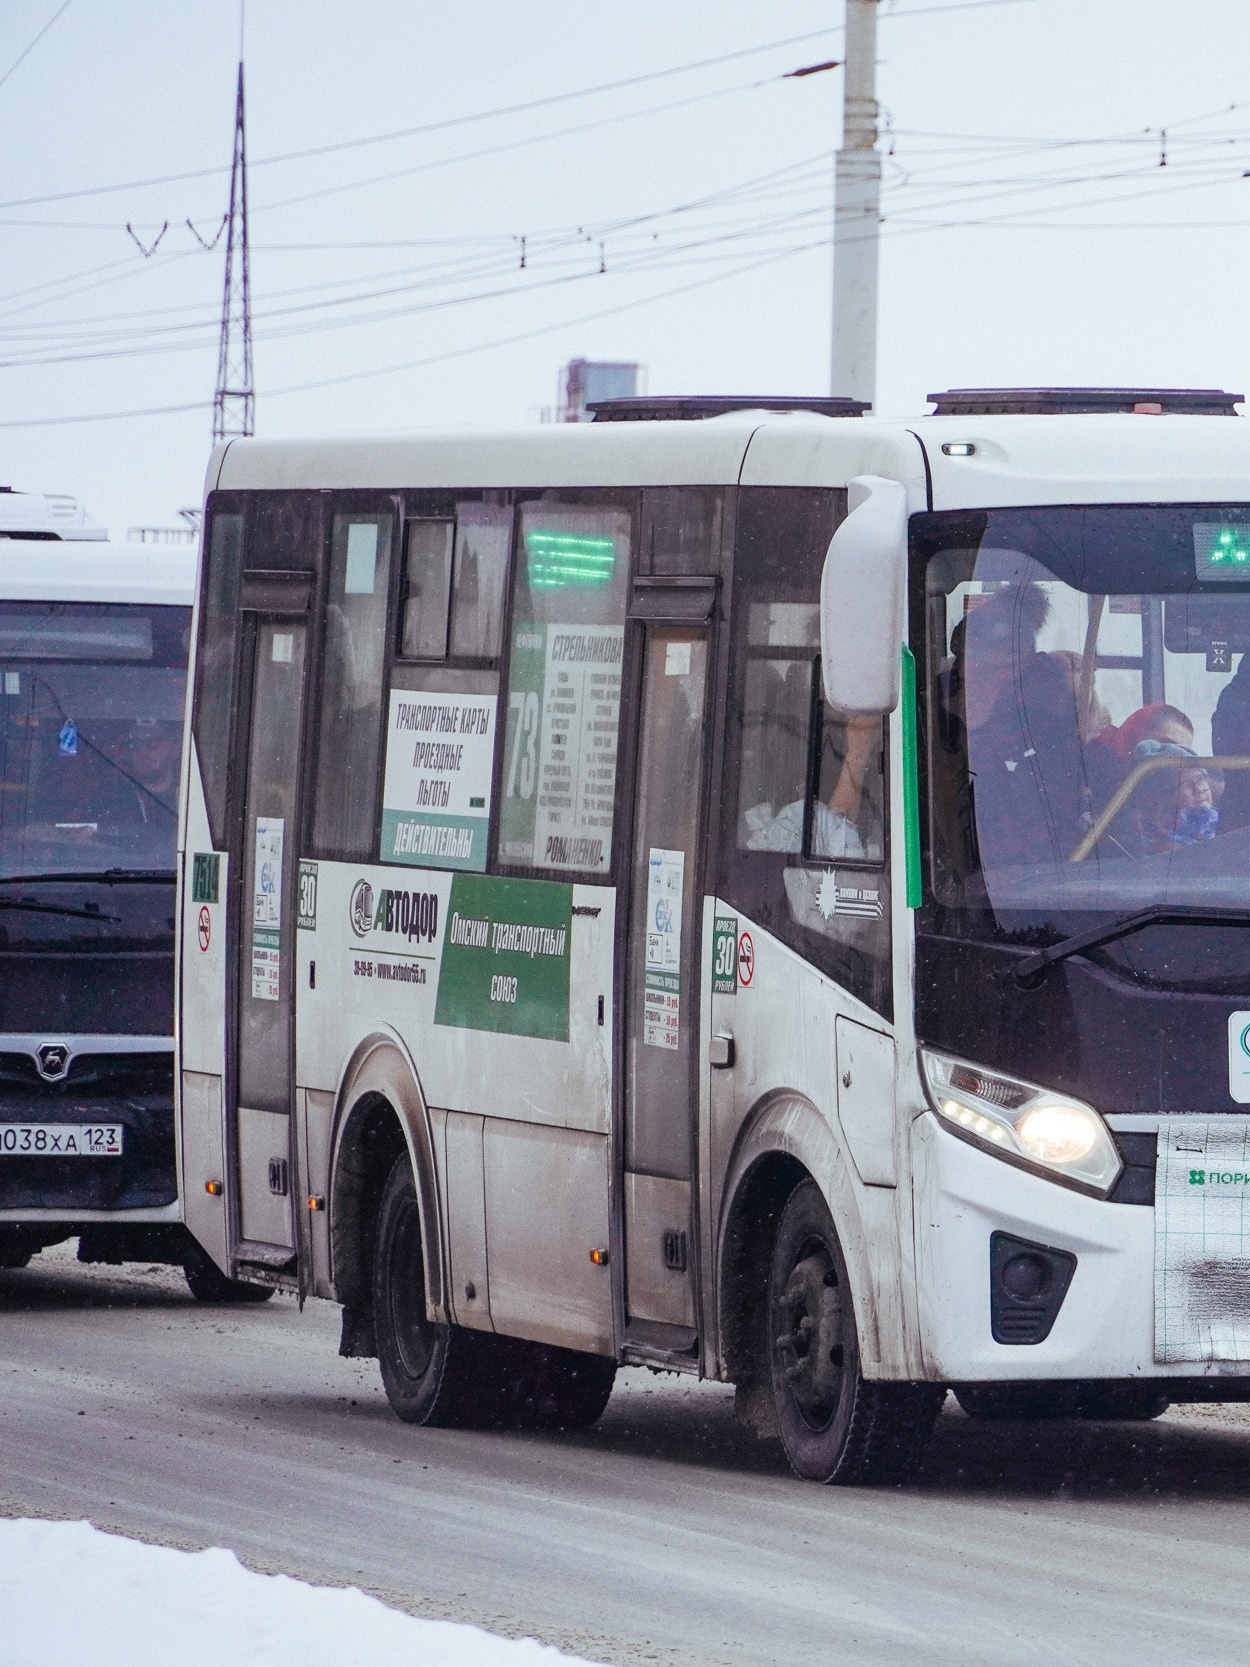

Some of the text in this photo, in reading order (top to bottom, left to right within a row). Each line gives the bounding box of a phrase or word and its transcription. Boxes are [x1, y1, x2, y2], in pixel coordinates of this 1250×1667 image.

[395, 703, 490, 735] ТРАНСПОРТНЫЕ КАРТЫ
[413, 741, 464, 774] ПРОЕЗДНЫЕ
[505, 691, 539, 799] 73
[416, 779, 452, 807] ЛЬГОТЫ
[393, 819, 474, 859] ДЕЙСТВИТЕЛЬНЫ
[300, 874, 316, 918] 30
[450, 912, 567, 959] Омский транспортный
[715, 920, 737, 934] ПРОЕЗД
[715, 935, 735, 976] 30
[0, 1128, 78, 1151] 038ХА
[84, 1128, 117, 1145] 123
